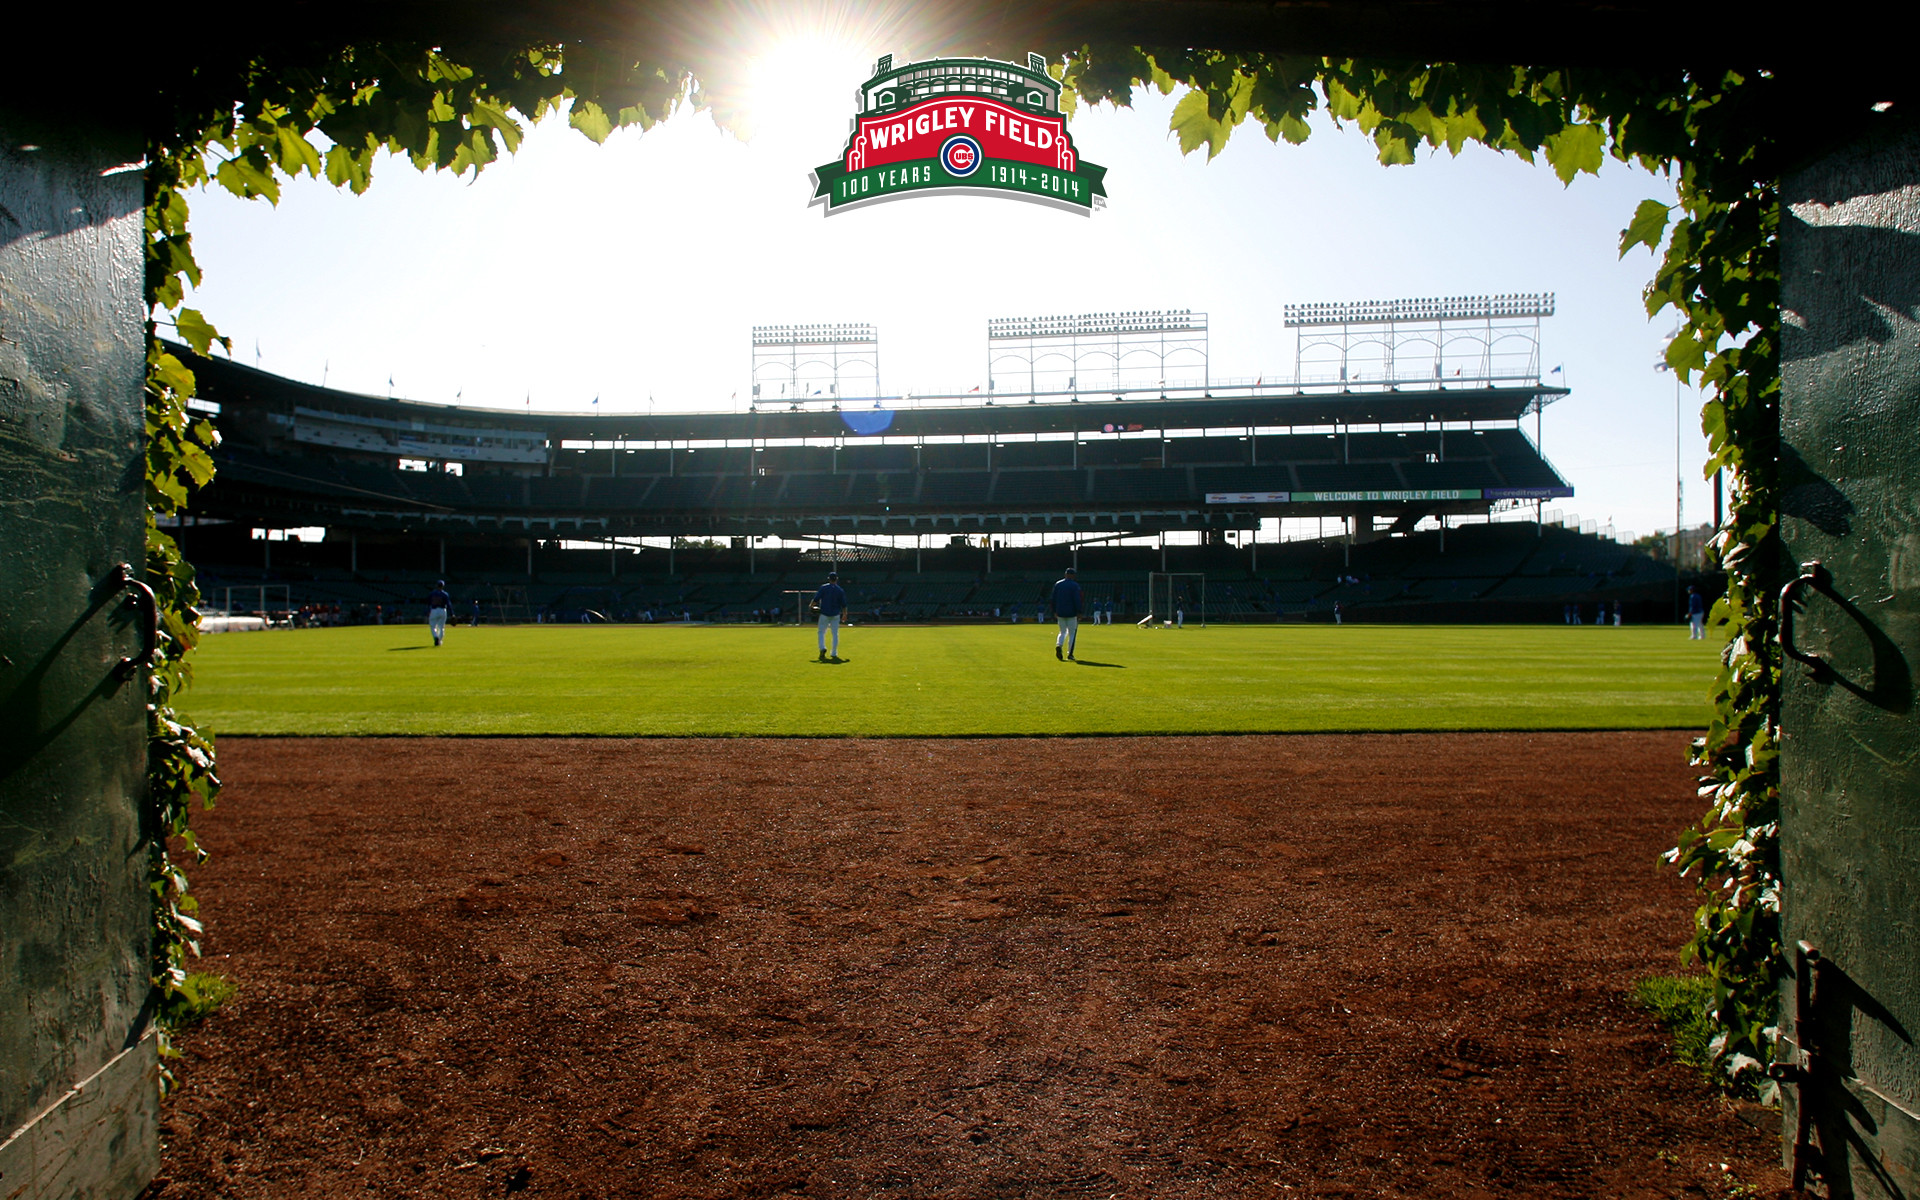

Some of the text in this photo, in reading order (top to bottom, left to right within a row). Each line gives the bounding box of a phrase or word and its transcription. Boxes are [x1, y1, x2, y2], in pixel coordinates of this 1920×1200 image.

[1314, 489, 1459, 501] WELCOME TO WRIGLEY FIELD
